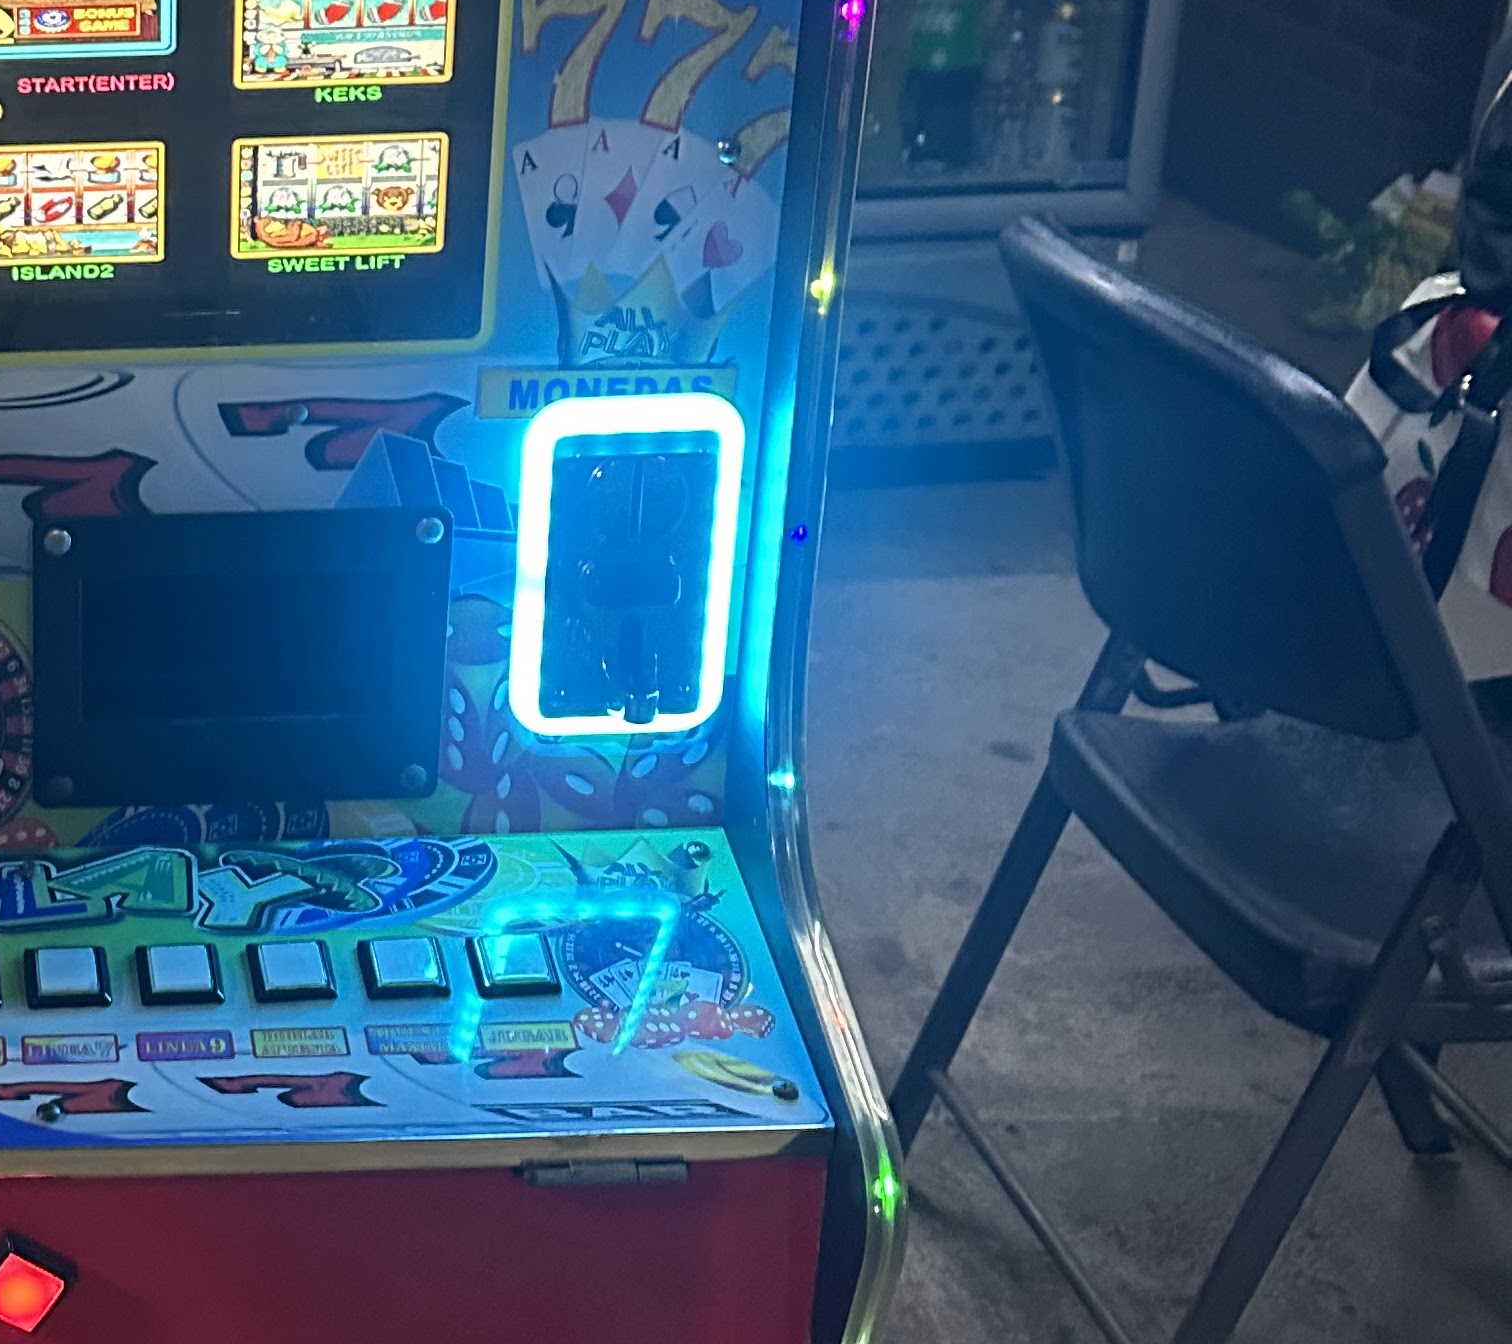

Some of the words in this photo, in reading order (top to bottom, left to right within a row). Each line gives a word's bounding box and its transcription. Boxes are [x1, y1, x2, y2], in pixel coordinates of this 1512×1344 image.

[17, 73, 176, 95] START(ENTER)
[314, 86, 383, 104] KEKS
[11, 263, 116, 282] ISLAND2
[267, 255, 350, 274] SWEET
[354, 253, 406, 272] LIFT
[144, 1040, 207, 1055] LINEA
